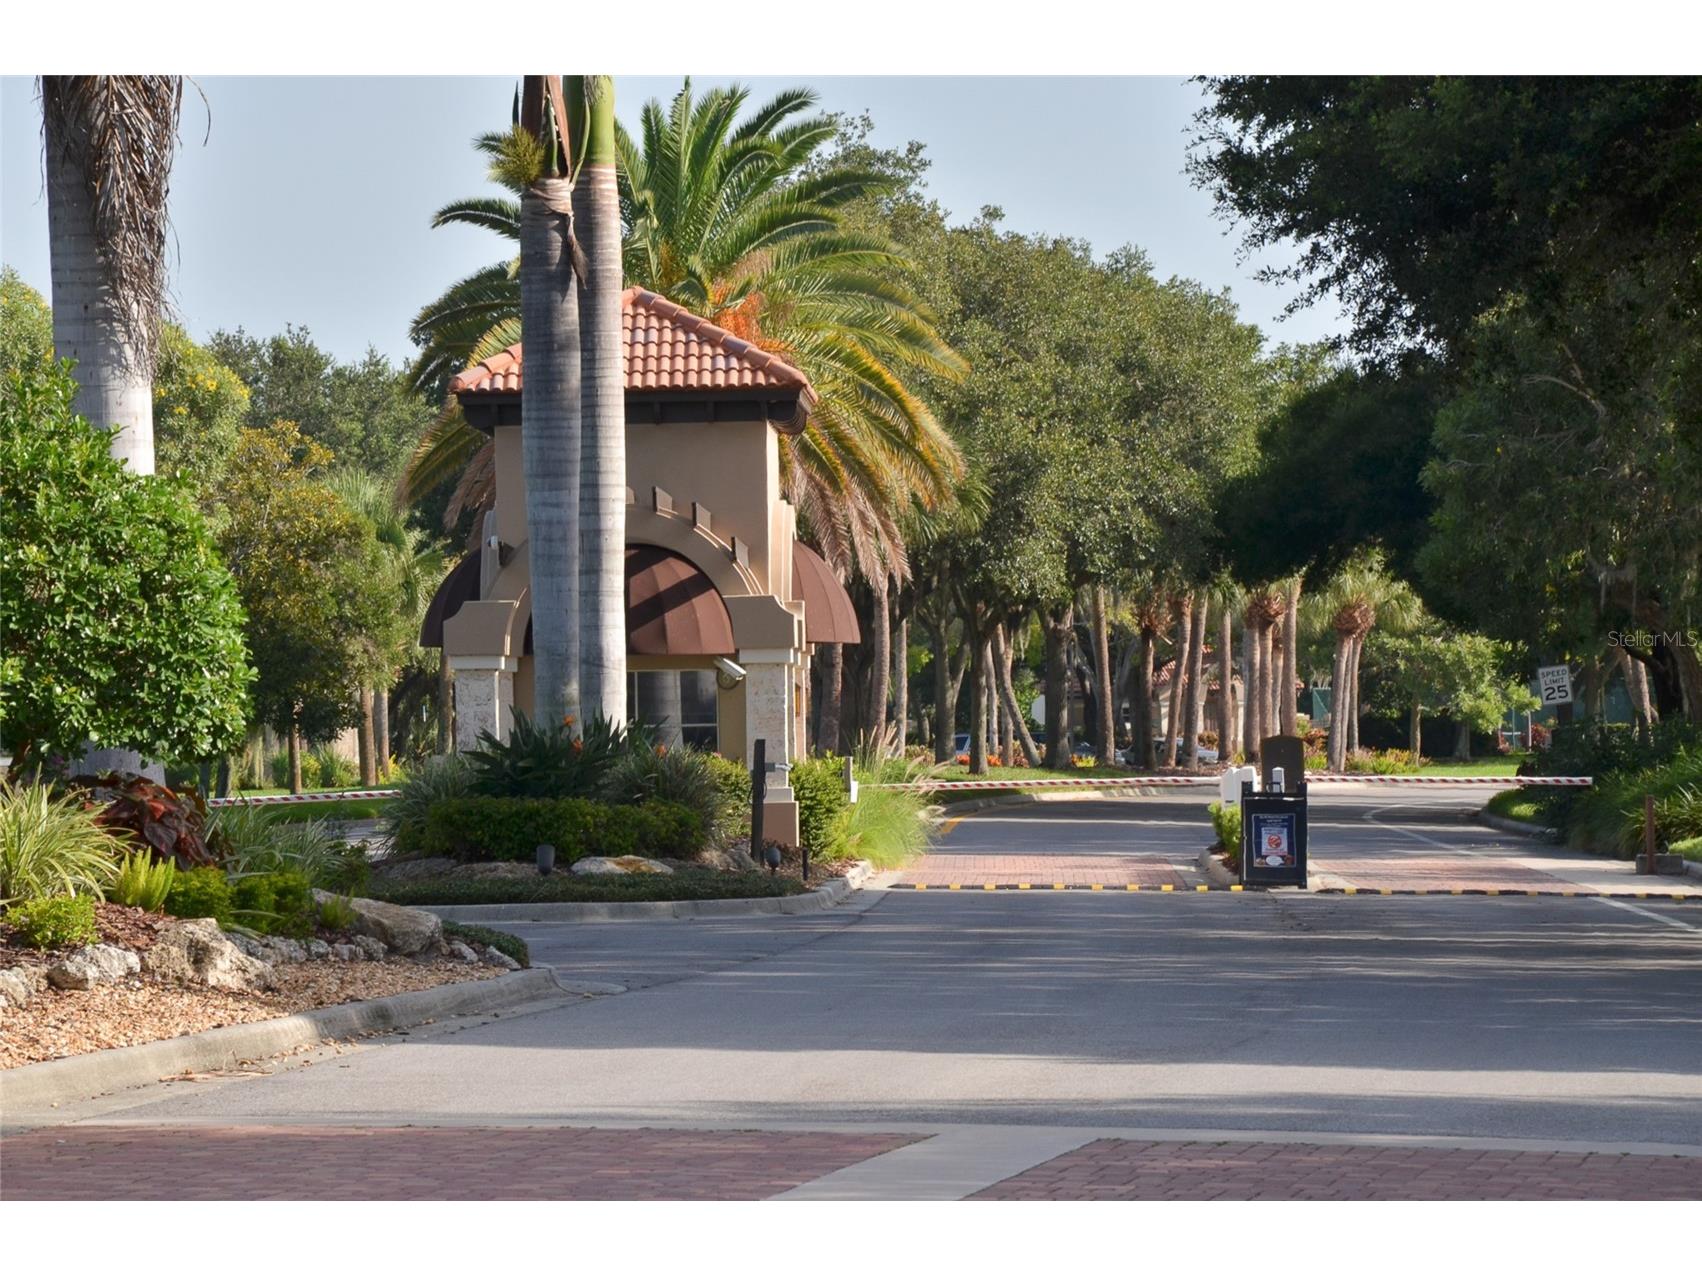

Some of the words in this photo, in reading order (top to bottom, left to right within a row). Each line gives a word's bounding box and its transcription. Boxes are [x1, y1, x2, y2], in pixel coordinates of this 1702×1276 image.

[1541, 668, 1567, 679] SPEED
[1544, 677, 1564, 686] LIMIT
[1544, 685, 1568, 701] 25
